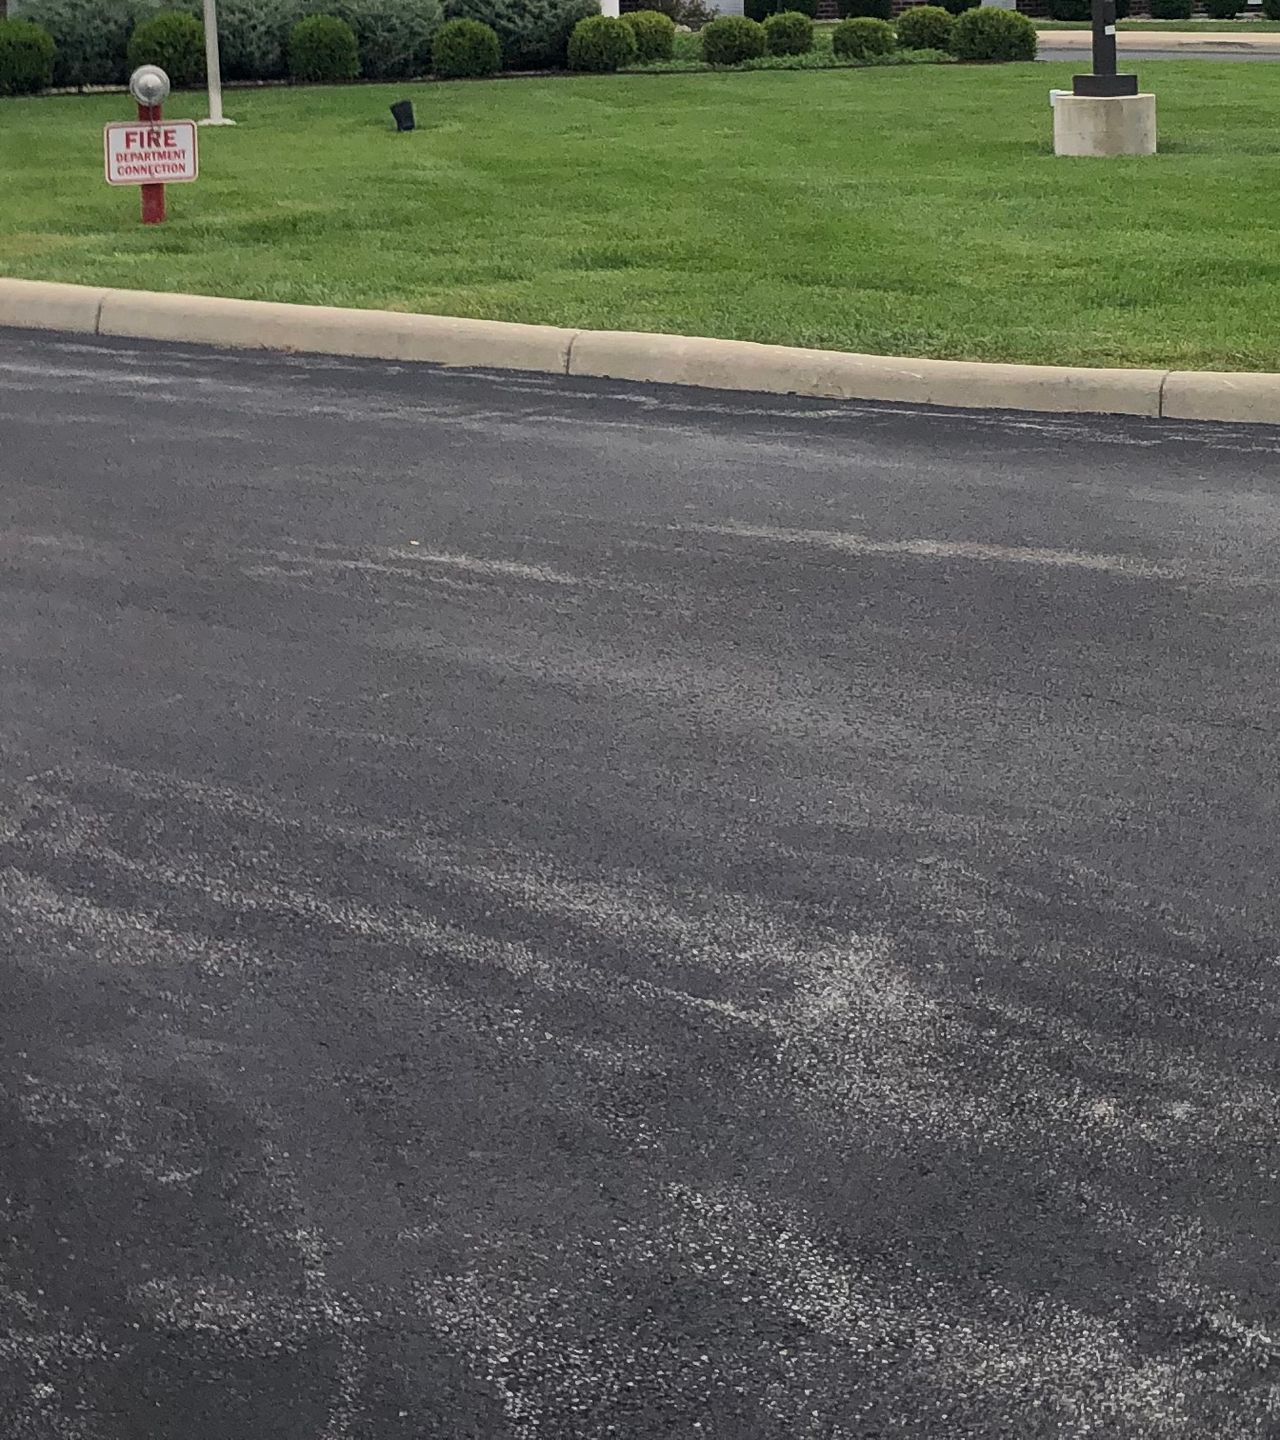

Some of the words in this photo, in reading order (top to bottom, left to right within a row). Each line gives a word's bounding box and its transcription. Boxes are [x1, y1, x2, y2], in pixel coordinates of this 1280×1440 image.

[125, 130, 177, 149] FIRE
[116, 150, 186, 163] DEPARTMENT
[117, 163, 186, 176] CONNECTION
